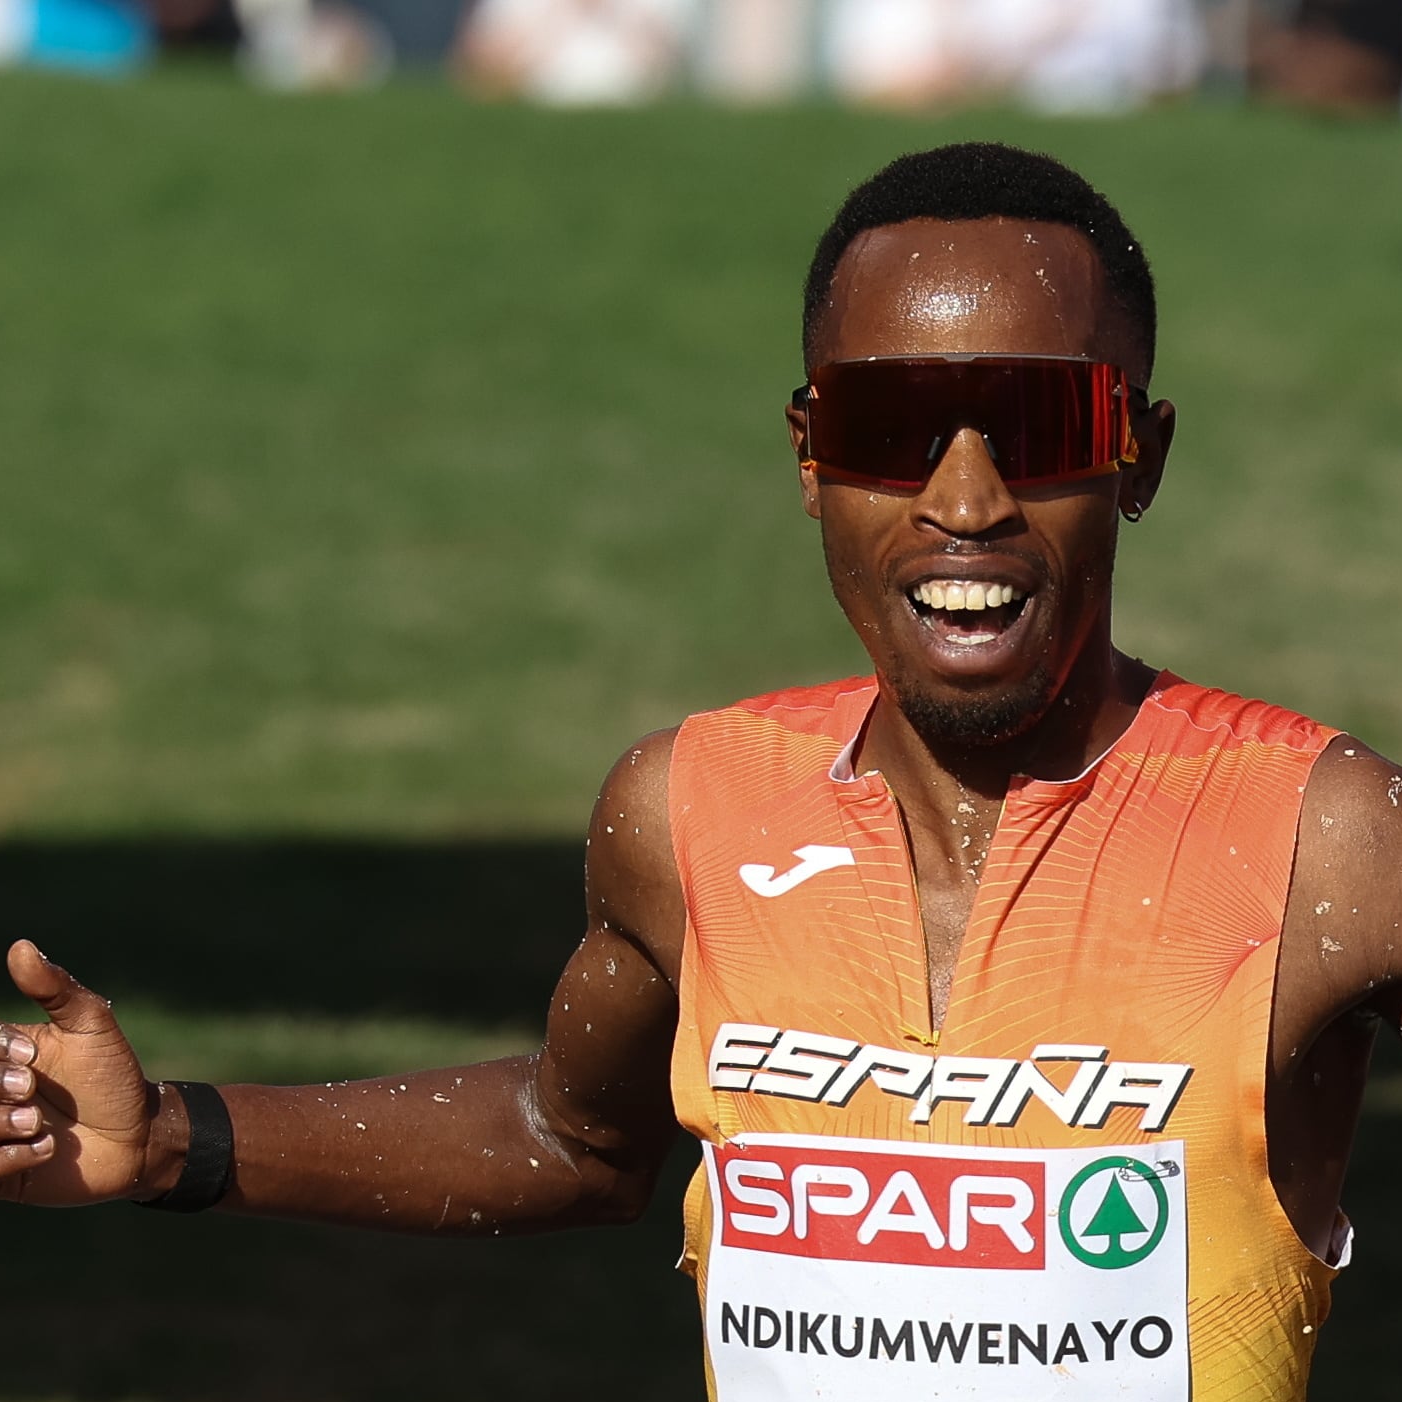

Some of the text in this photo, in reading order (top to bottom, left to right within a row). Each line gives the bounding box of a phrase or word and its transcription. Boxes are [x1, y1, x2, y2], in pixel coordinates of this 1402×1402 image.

[709, 1022, 1195, 1133] ESPAÑA
[722, 1157, 1036, 1254] SPAR
[720, 1301, 1174, 1366] NDIKUMWENAYO
